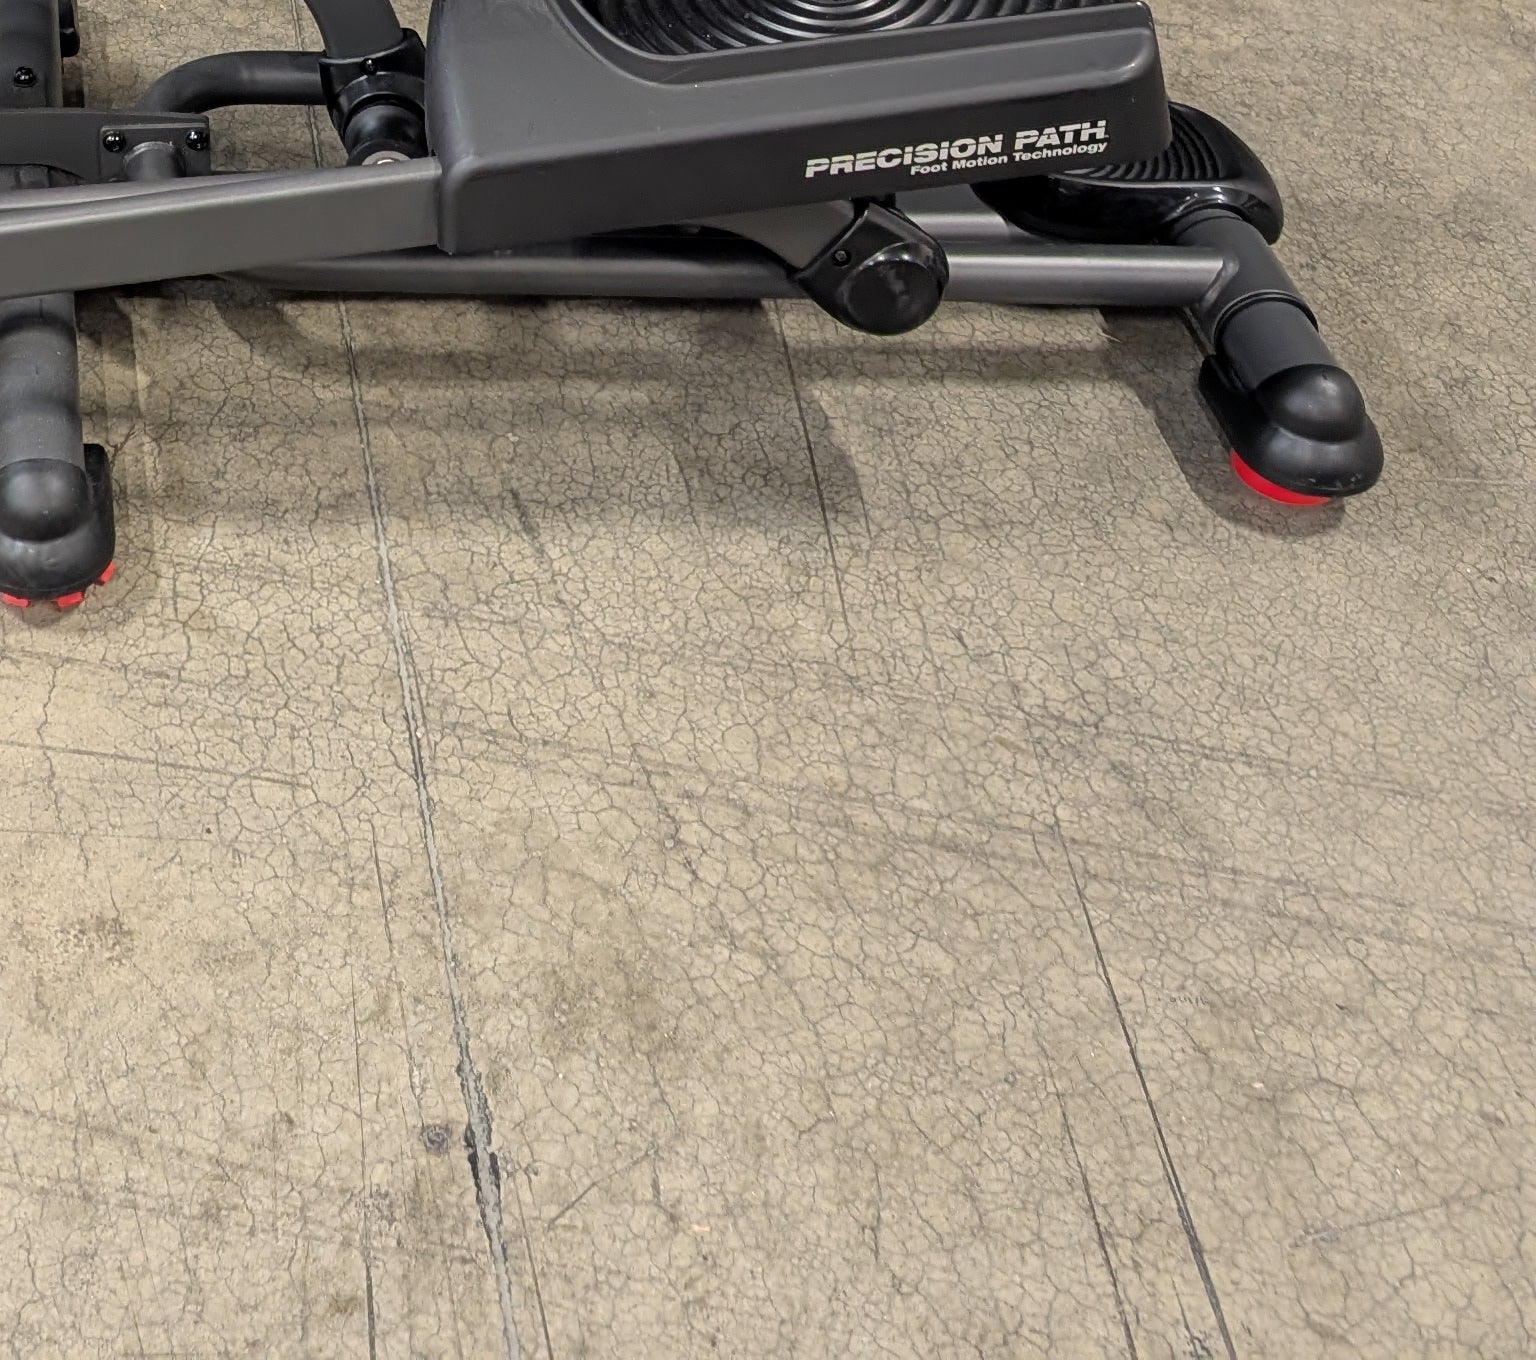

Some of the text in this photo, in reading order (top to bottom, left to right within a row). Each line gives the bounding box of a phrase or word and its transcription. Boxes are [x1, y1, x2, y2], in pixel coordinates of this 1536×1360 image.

[805, 120, 1108, 178] PRECISION PATH
[910, 141, 1108, 176] Foot Motion Technology
